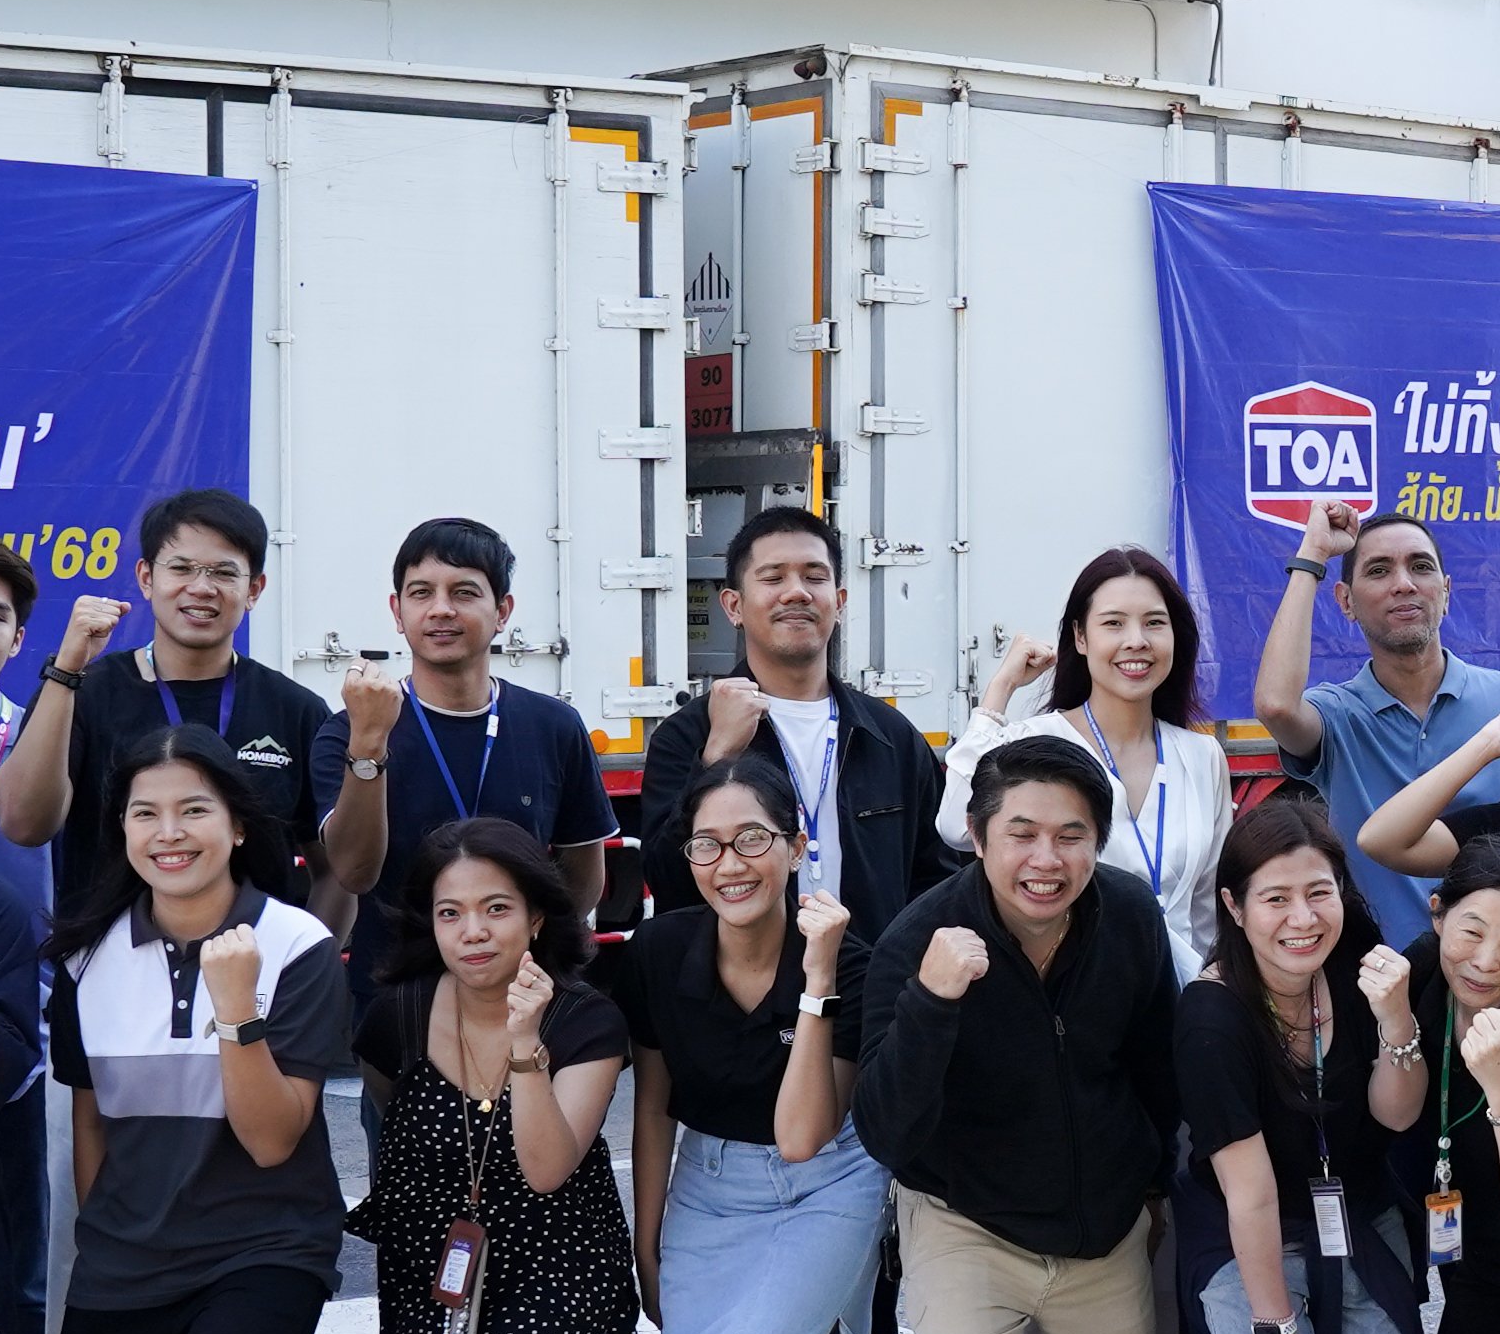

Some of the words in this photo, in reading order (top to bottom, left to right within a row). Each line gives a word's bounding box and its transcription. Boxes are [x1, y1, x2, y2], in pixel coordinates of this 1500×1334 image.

[701, 365, 722, 387] 90
[1254, 428, 1368, 487] TOA
[237, 750, 291, 766] HOMEBOY
